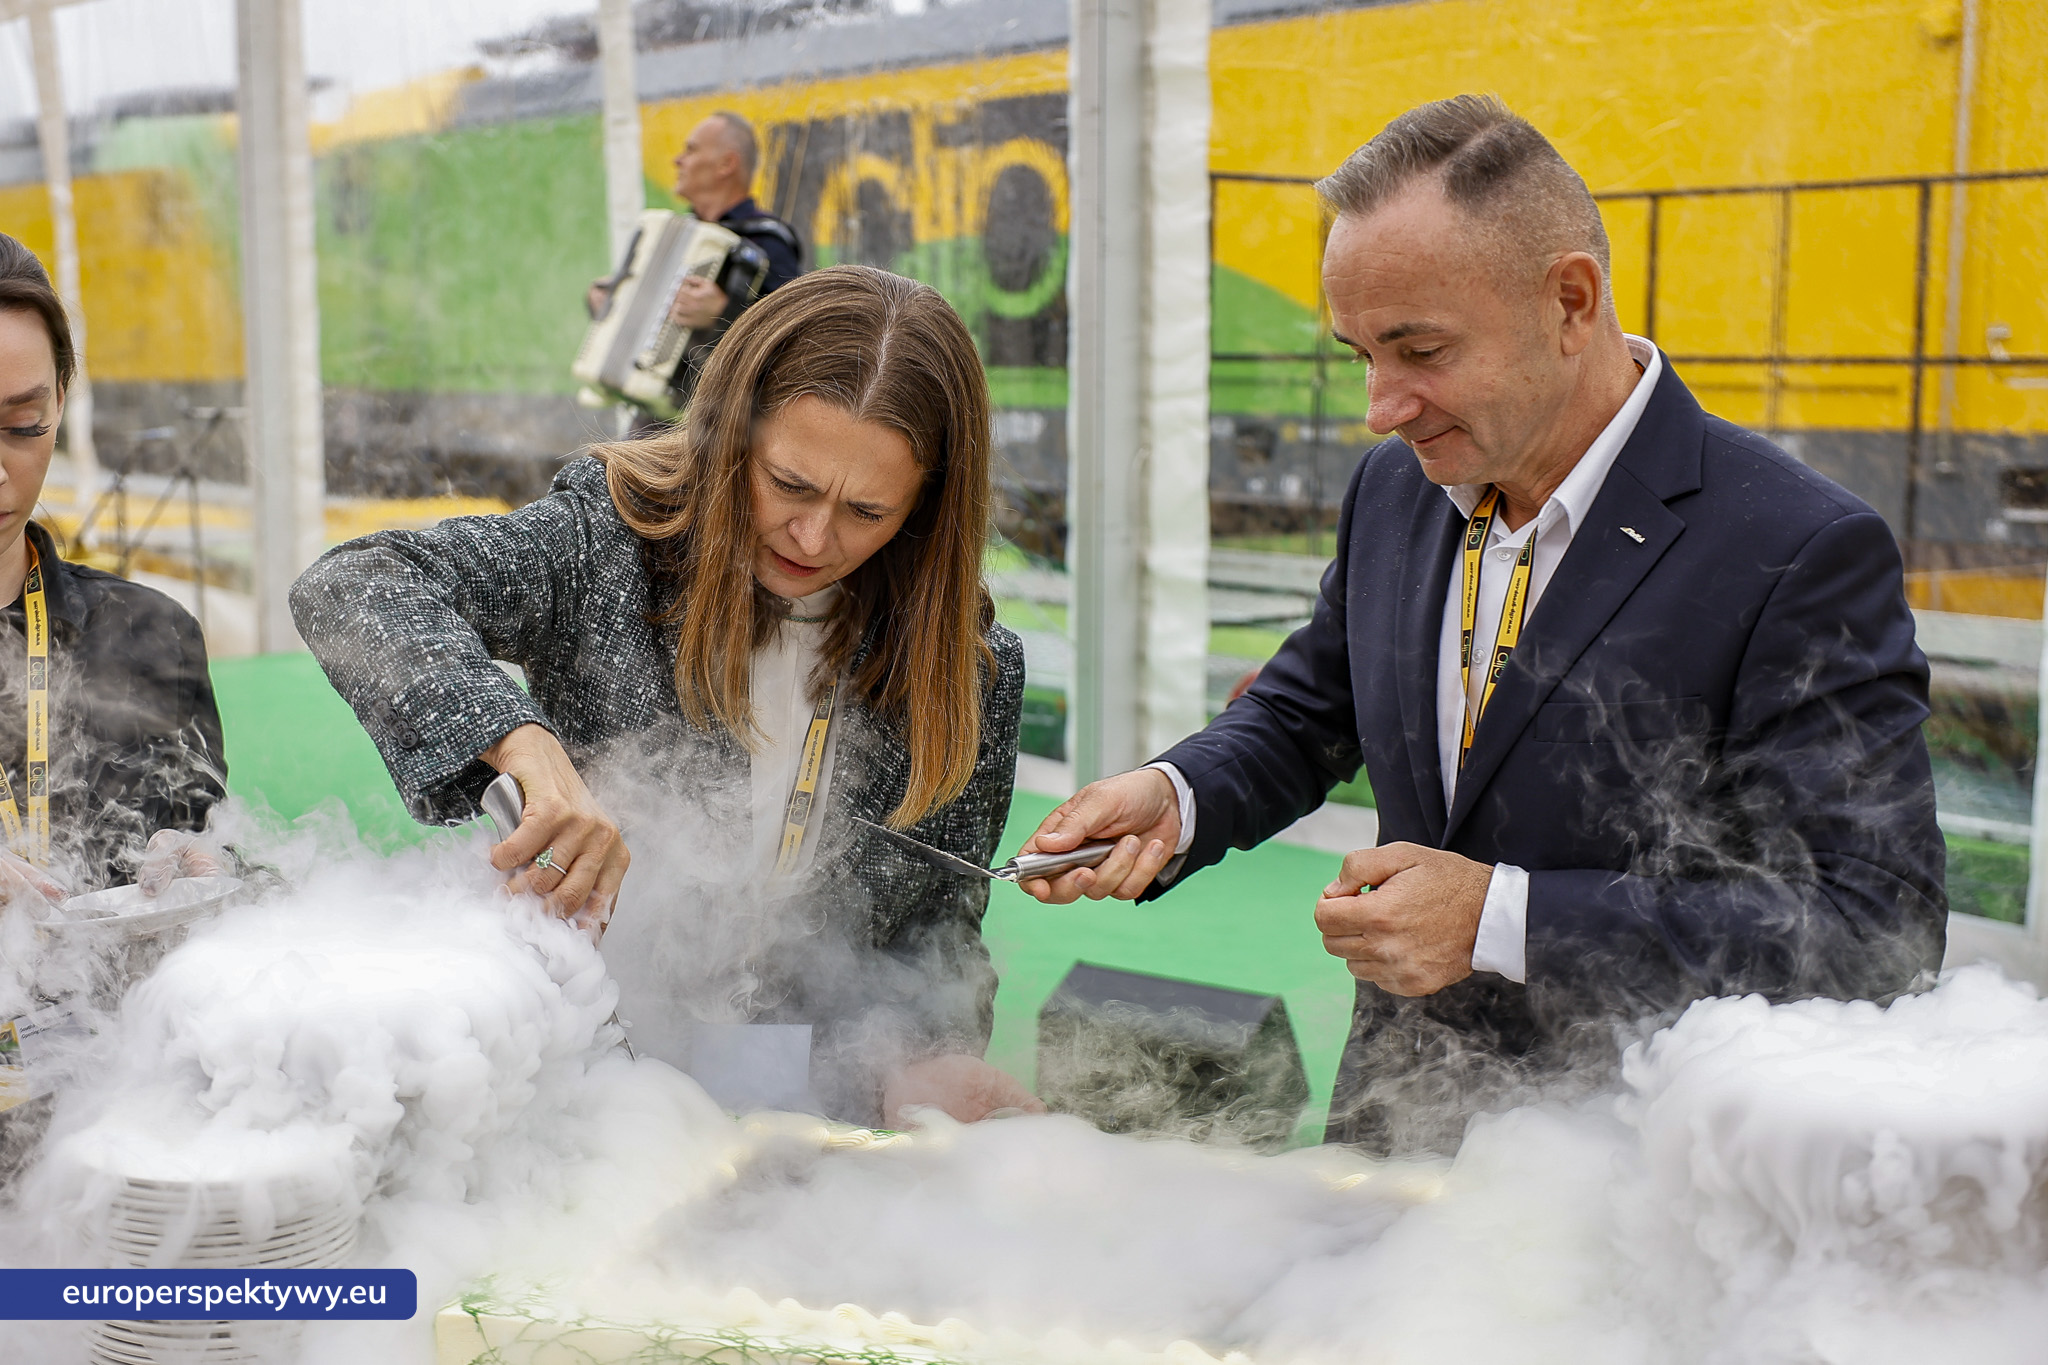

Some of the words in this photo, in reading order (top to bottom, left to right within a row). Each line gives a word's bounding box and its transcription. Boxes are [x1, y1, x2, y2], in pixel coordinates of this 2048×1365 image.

[1468, 521, 1485, 545] clip
[1507, 577, 1522, 635] www.clip-group.com
[30, 661, 43, 686] clip
[793, 796, 808, 819] clip
